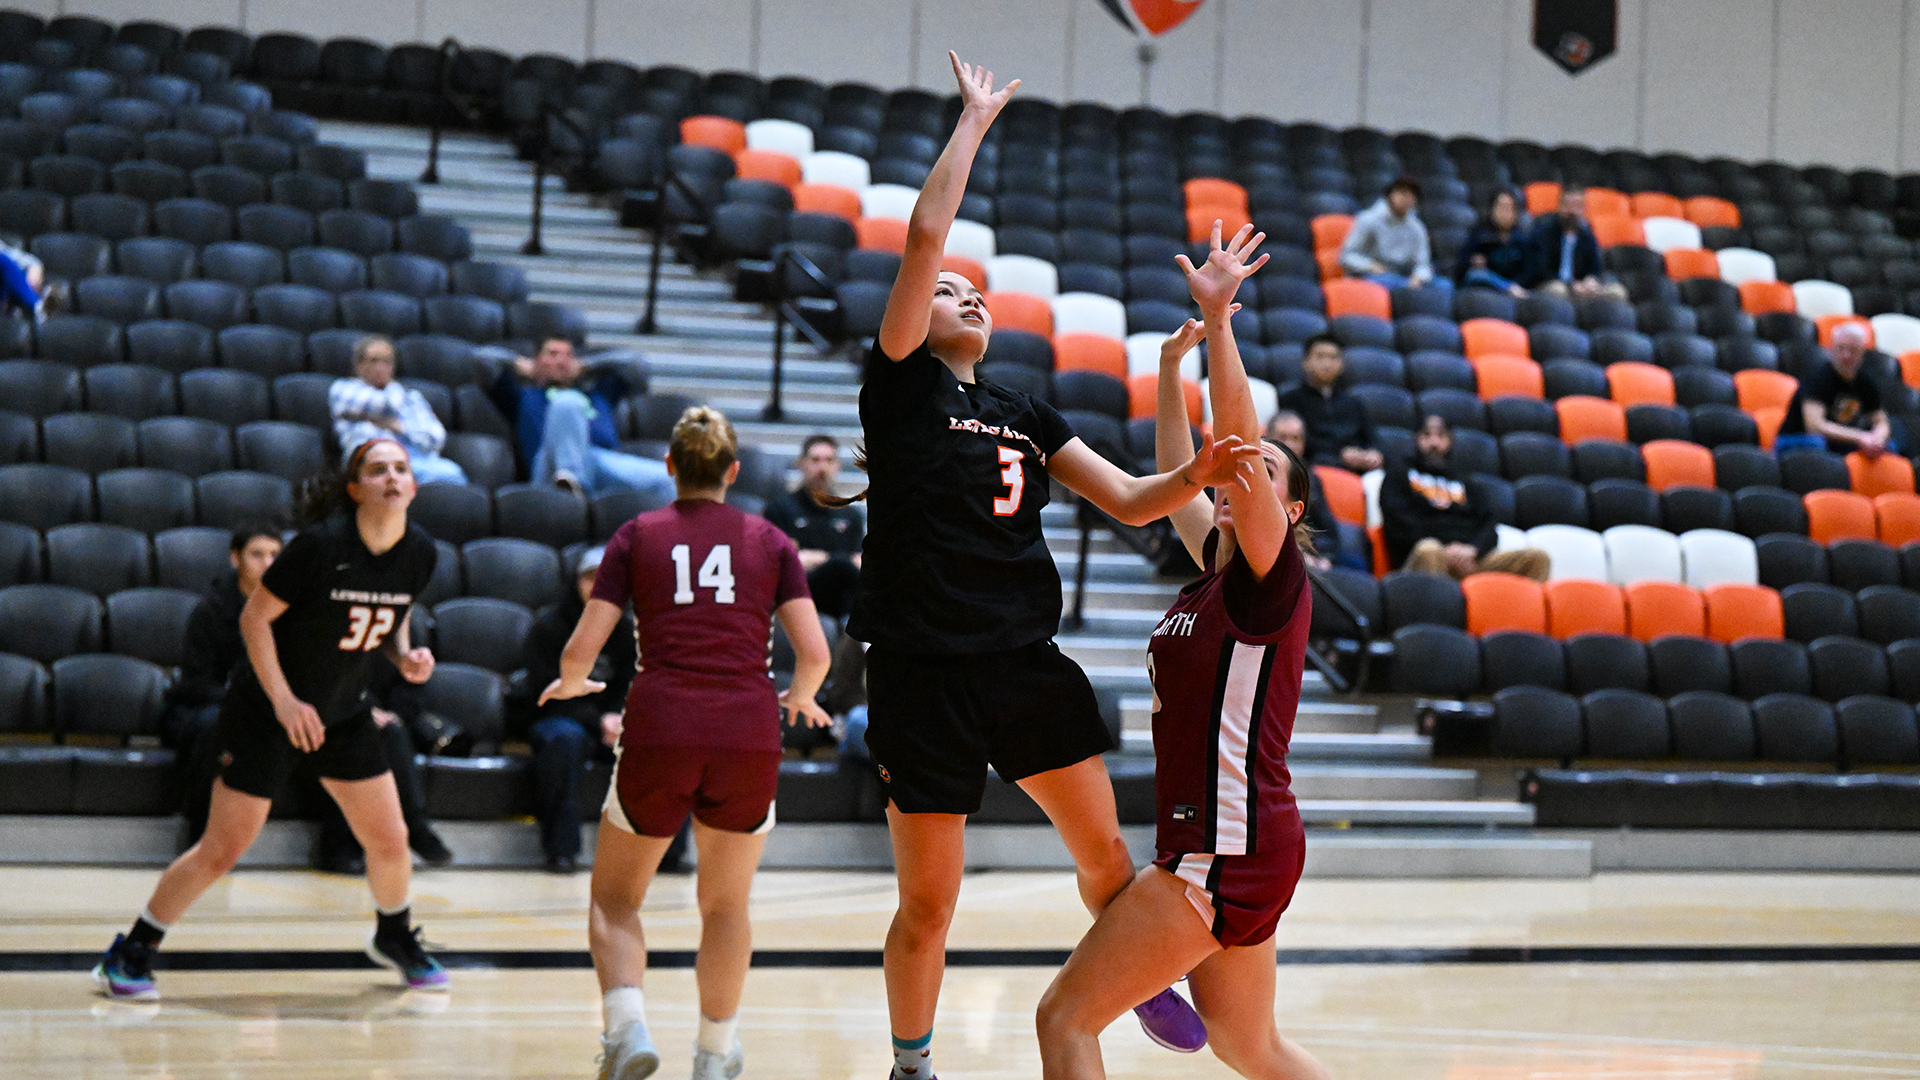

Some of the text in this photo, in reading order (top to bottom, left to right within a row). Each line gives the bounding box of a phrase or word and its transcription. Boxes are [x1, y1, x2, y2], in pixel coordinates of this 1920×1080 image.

[993, 446, 1025, 516] 3
[671, 544, 736, 605] 14
[338, 605, 395, 652] 32
